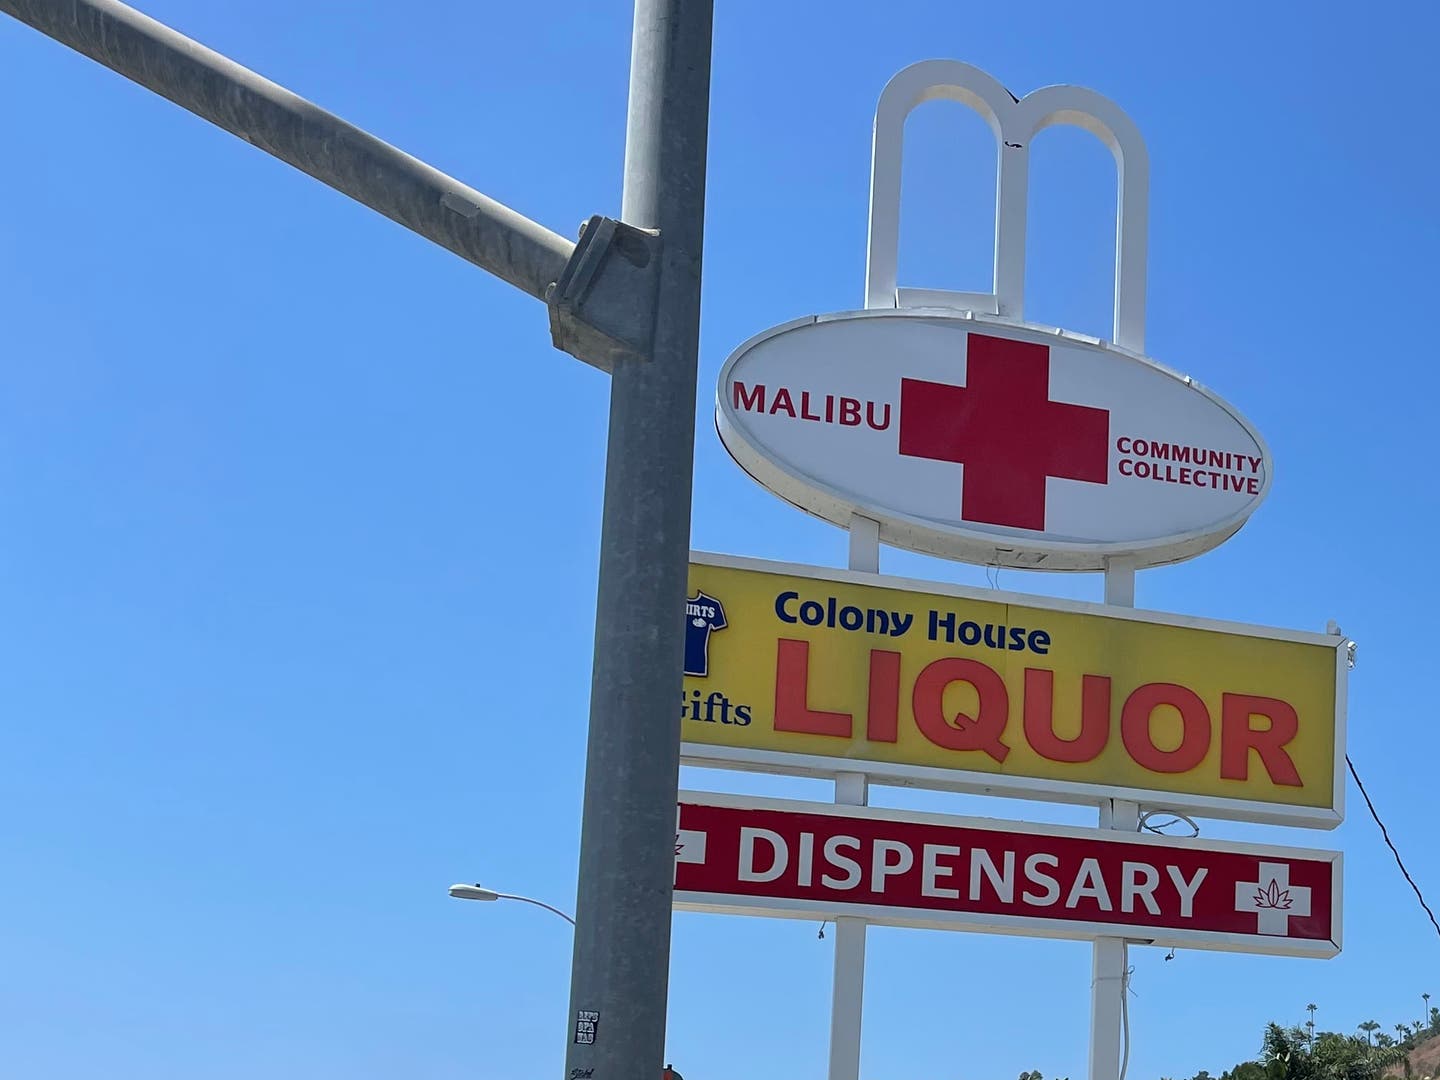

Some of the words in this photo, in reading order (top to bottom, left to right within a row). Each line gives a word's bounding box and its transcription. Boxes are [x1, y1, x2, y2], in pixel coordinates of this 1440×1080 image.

[733, 381, 892, 432] MALIBU
[1116, 436, 1262, 474] COMMUNITY
[1118, 458, 1260, 496] COLLECTIVE
[774, 590, 914, 638] Colony
[927, 611, 1052, 655] House
[774, 638, 1304, 787] LIQUOR
[737, 826, 1209, 918] DISPENSARY
